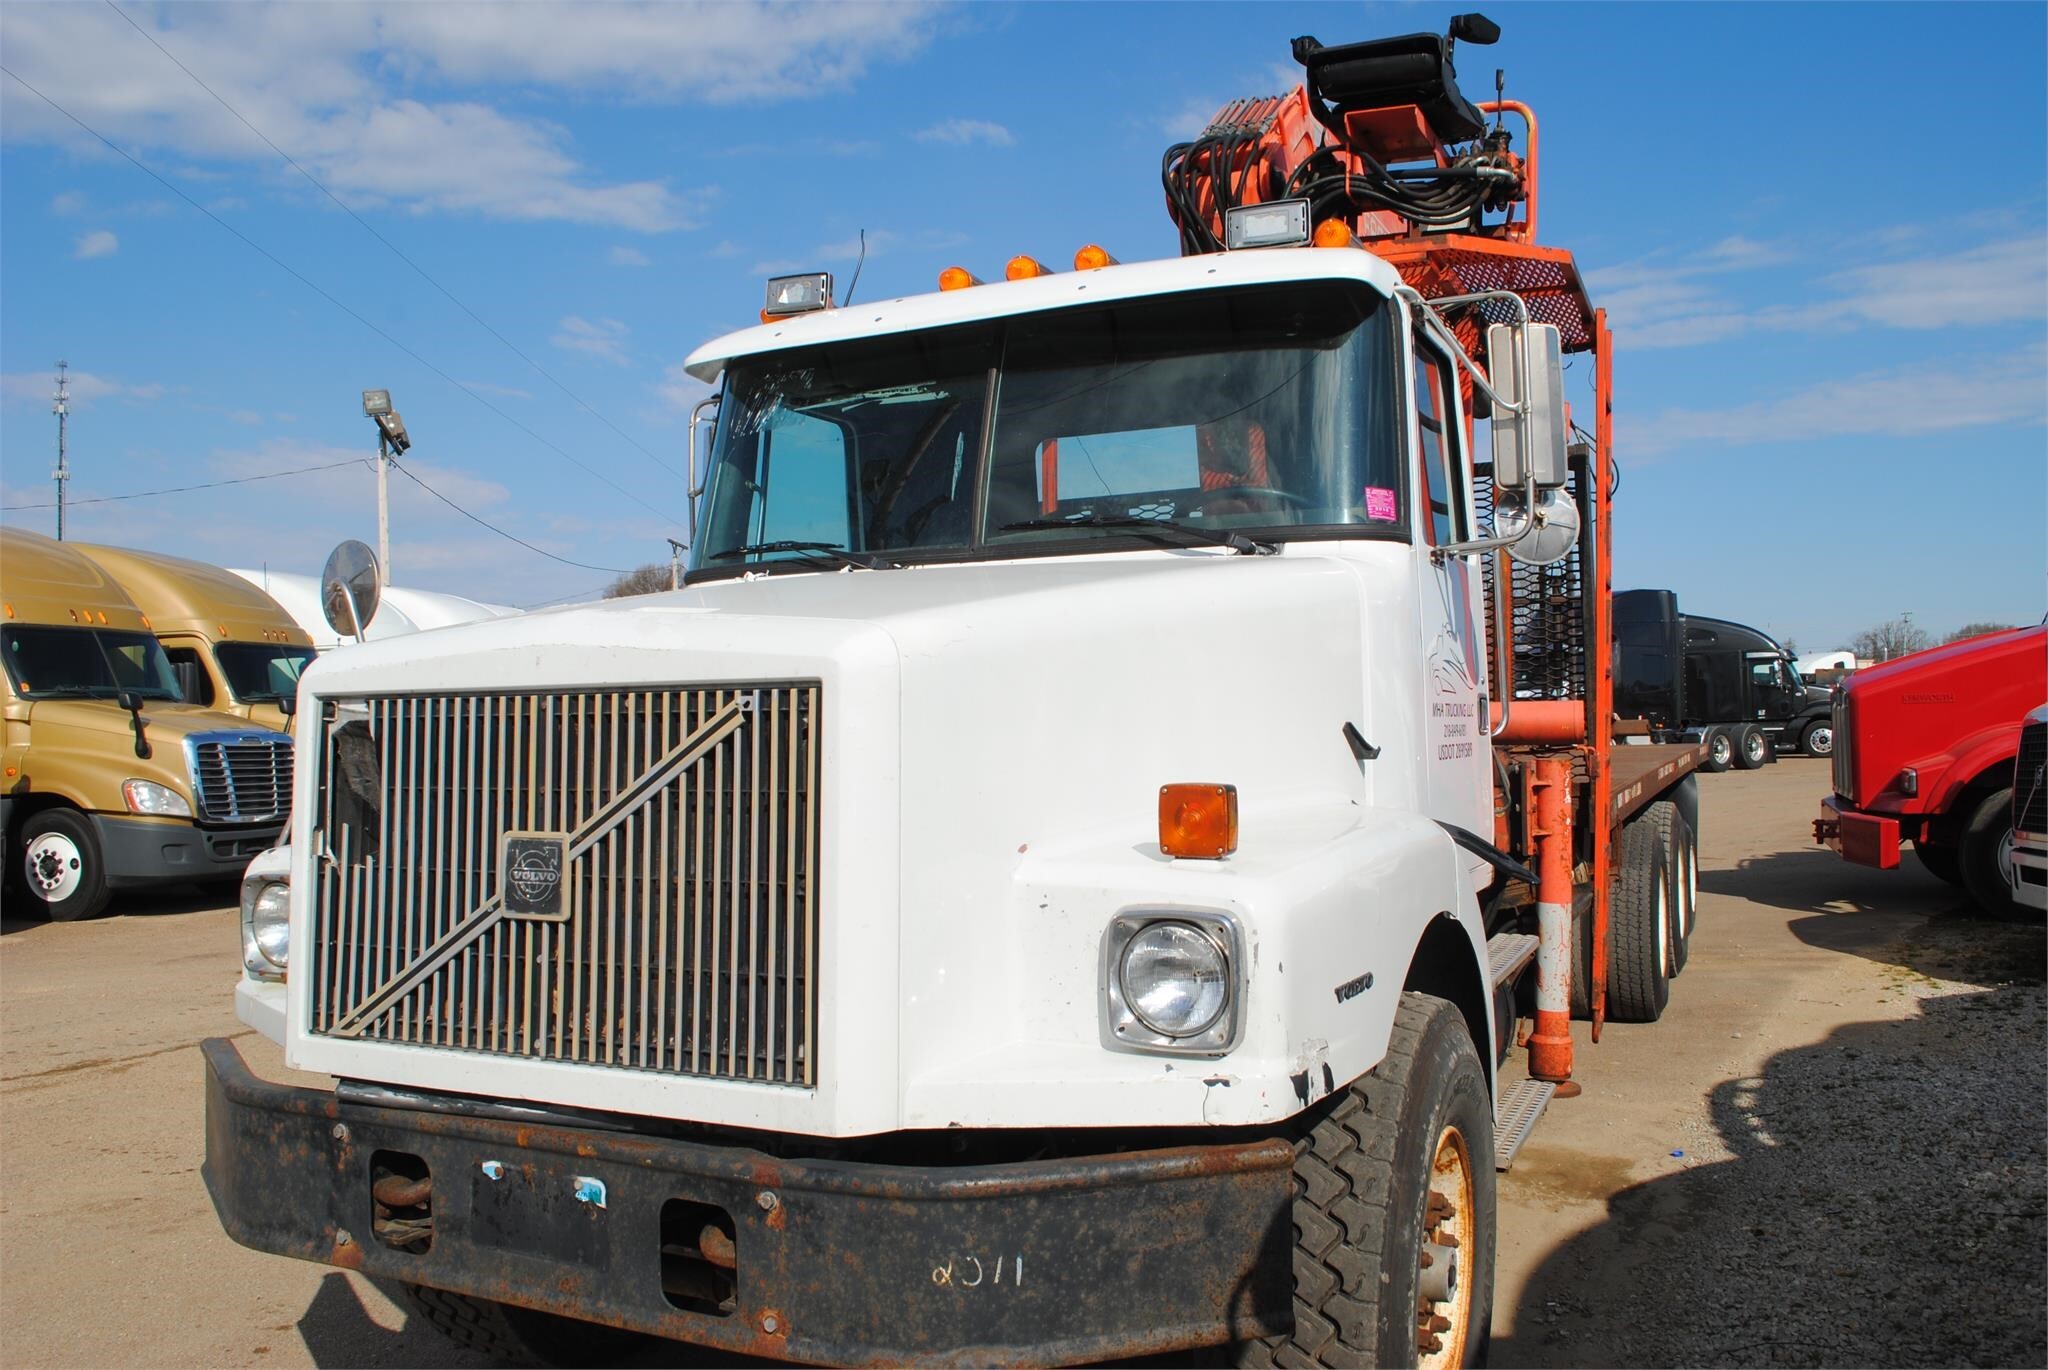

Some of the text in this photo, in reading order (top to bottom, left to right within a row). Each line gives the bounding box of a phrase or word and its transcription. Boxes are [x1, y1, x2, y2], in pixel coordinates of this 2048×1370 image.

[1445, 703, 1466, 718] TRUCKING
[1438, 744, 1455, 760] USDOT
[513, 871, 556, 881] VOLVO
